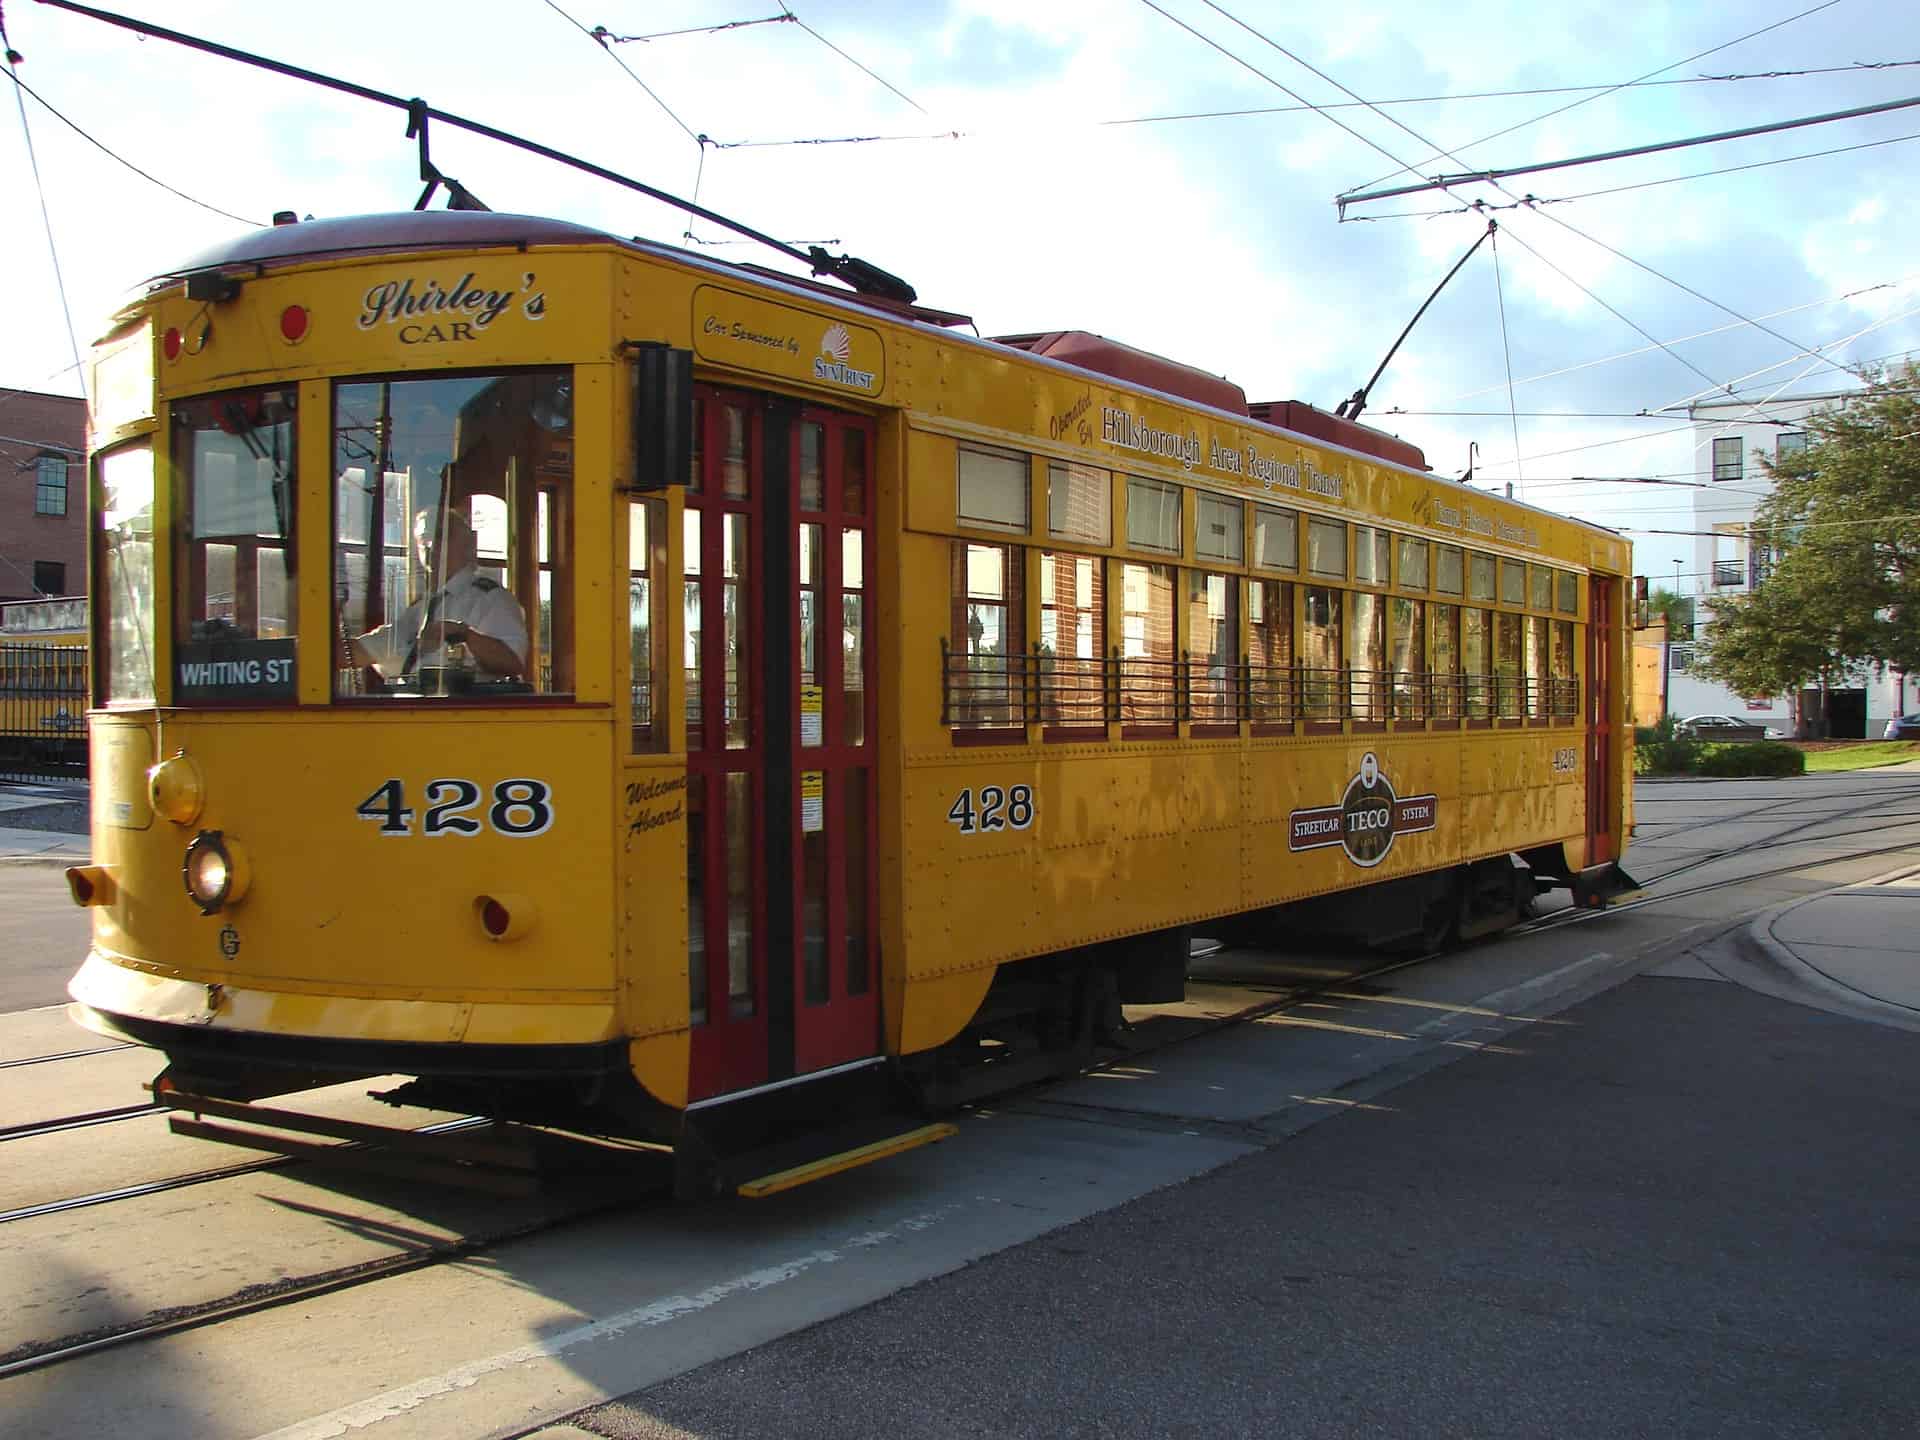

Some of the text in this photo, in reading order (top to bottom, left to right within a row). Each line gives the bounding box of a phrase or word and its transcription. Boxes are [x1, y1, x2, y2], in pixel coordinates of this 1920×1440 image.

[358, 272, 544, 330] Shirley's
[398, 322, 477, 344] CAR
[703, 315, 800, 357] Car Sponsored by
[1101, 407, 1343, 499] Hillsborough Area Regional Transit
[181, 657, 292, 686] WHITING ST
[356, 778, 554, 838] 428
[626, 775, 687, 805] Welcome
[627, 800, 683, 846] Aboard
[948, 784, 1033, 834] 428
[1346, 808, 1389, 832] TECO
[1401, 806, 1430, 821] SYSTEM
[1294, 818, 1340, 838] STREETCAR
